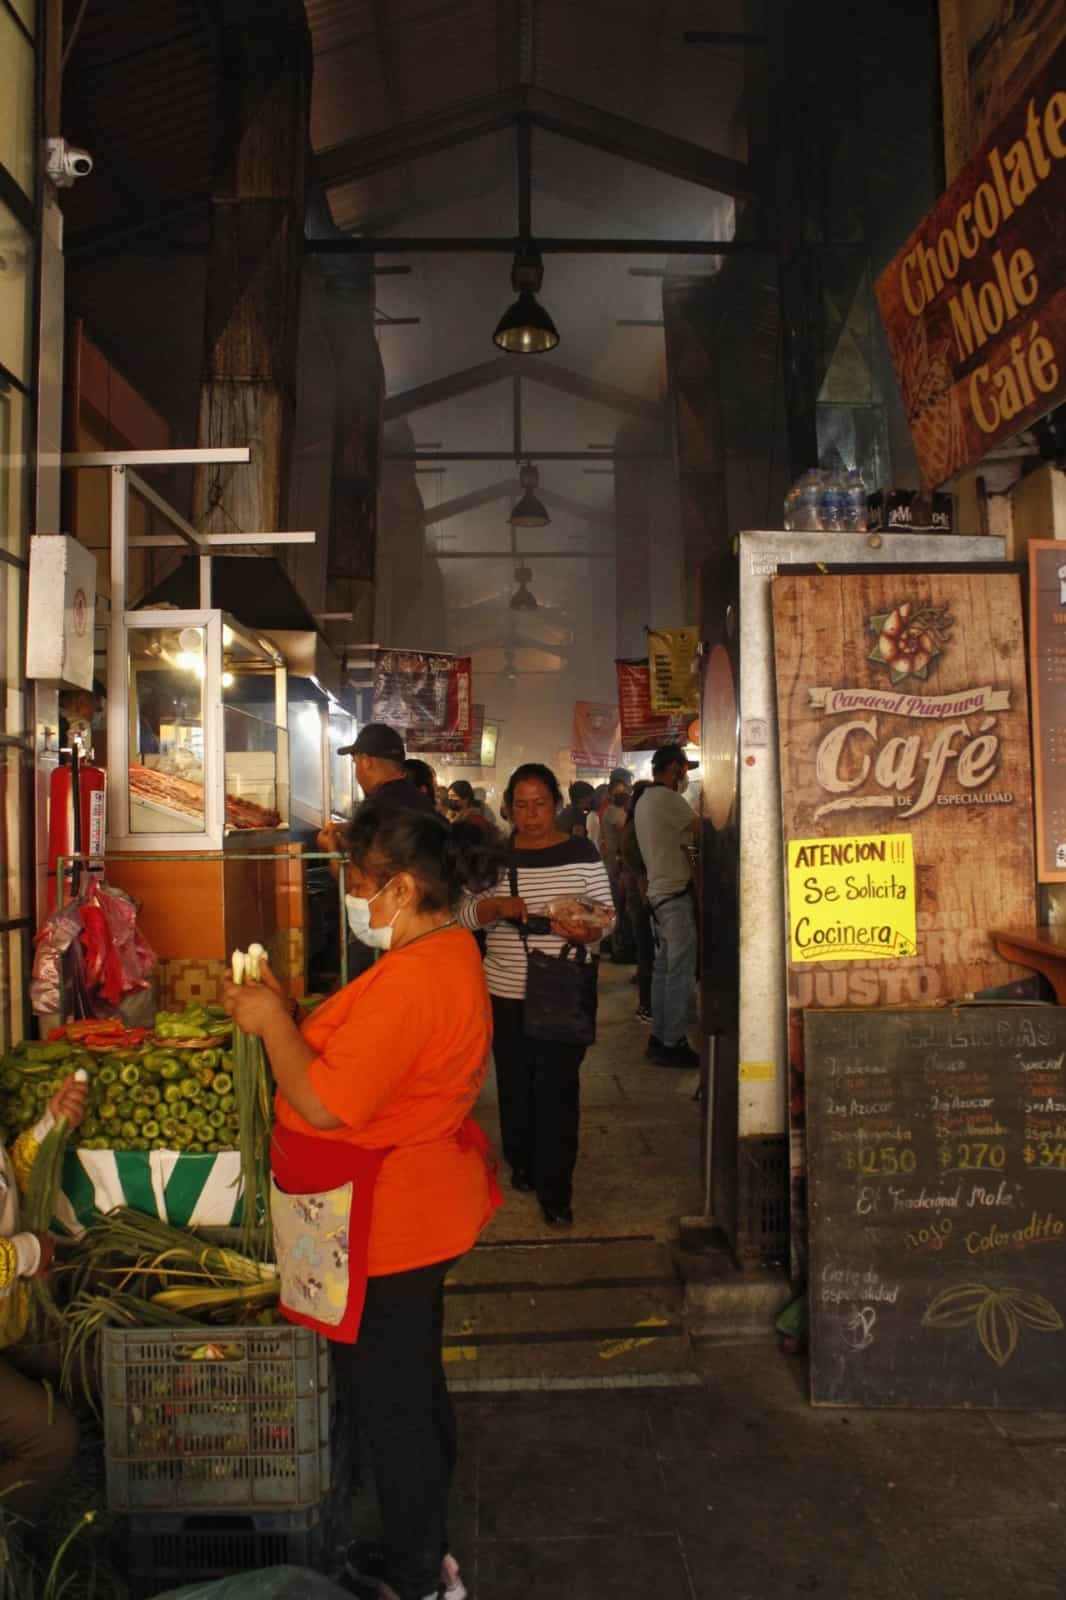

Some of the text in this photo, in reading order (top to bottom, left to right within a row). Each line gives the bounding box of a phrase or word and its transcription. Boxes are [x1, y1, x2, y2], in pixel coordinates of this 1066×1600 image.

[902, 90, 1066, 317] Chocolate
[949, 247, 1039, 364] Mole
[969, 320, 1060, 435] Café
[832, 690, 904, 713] Caracol
[816, 716, 998, 819] Café
[896, 792, 1014, 807] DE ESPECIALIDAD
[804, 873, 906, 904] Se Solicita
[794, 916, 891, 948] Cocinera
[788, 967, 942, 1007] JUSTO
